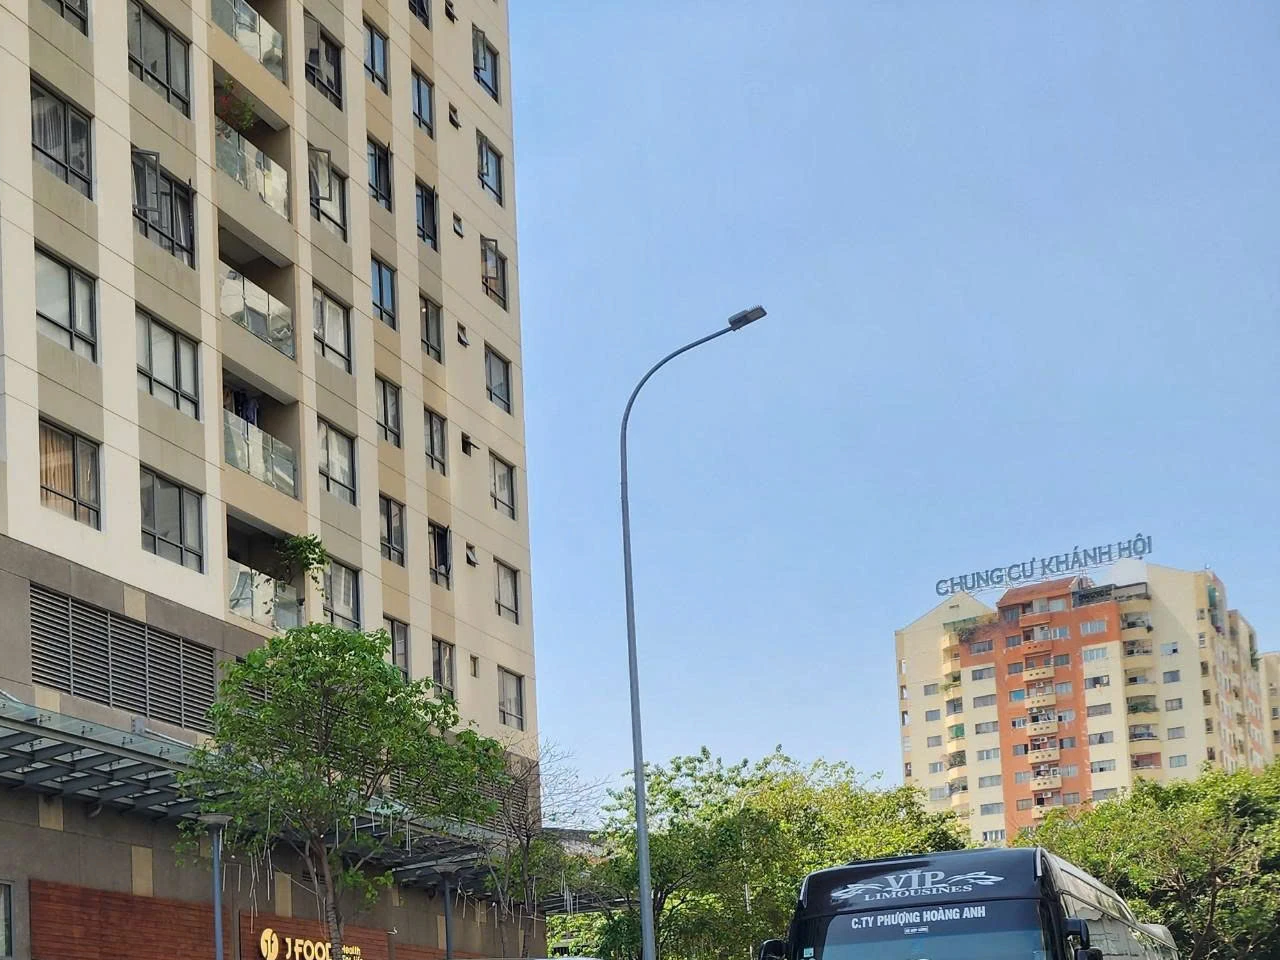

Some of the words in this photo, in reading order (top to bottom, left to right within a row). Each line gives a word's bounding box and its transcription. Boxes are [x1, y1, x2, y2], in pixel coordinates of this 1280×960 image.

[935, 567, 1005, 596] CHUNG
[1007, 557, 1036, 582] CƯ
[1041, 544, 1113, 576] KHÁNH
[1118, 533, 1153, 560] HỘI
[885, 870, 946, 890] VIP
[864, 884, 973, 901] LIMOUSINES
[851, 916, 874, 929] C.TY
[877, 911, 920, 926] PHƯỢNG
[923, 907, 960, 923] HOÀNG
[962, 906, 986, 918] ANH
